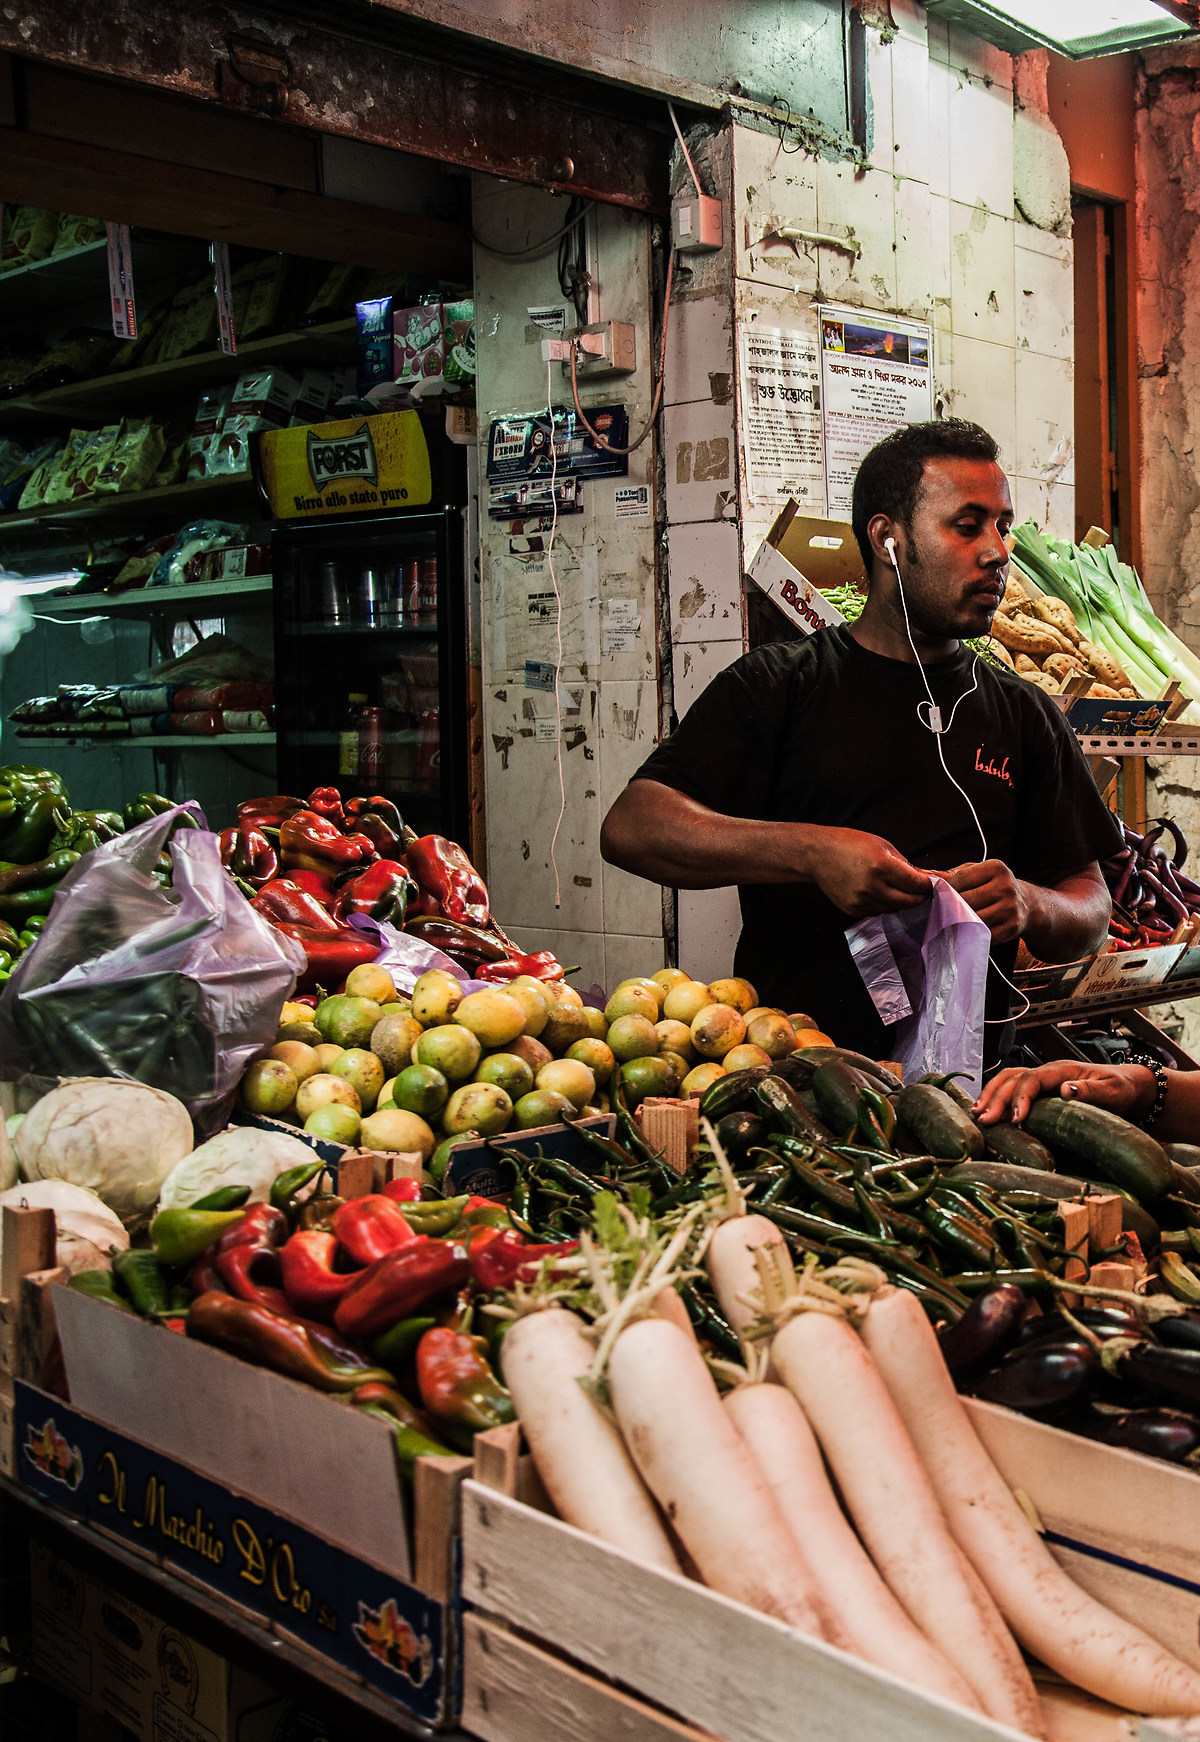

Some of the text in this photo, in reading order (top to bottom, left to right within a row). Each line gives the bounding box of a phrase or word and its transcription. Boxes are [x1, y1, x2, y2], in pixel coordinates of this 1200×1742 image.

[758, 384, 776, 399] শুভ
[908, 377, 927, 389] ২০১৭
[312, 441, 369, 475] FORST
[293, 487, 409, 511] Birra allo stato puro
[780, 579, 827, 630] Bont
[131, 1474, 225, 1566] Marchio
[231, 1516, 313, 1615] D'Oro
